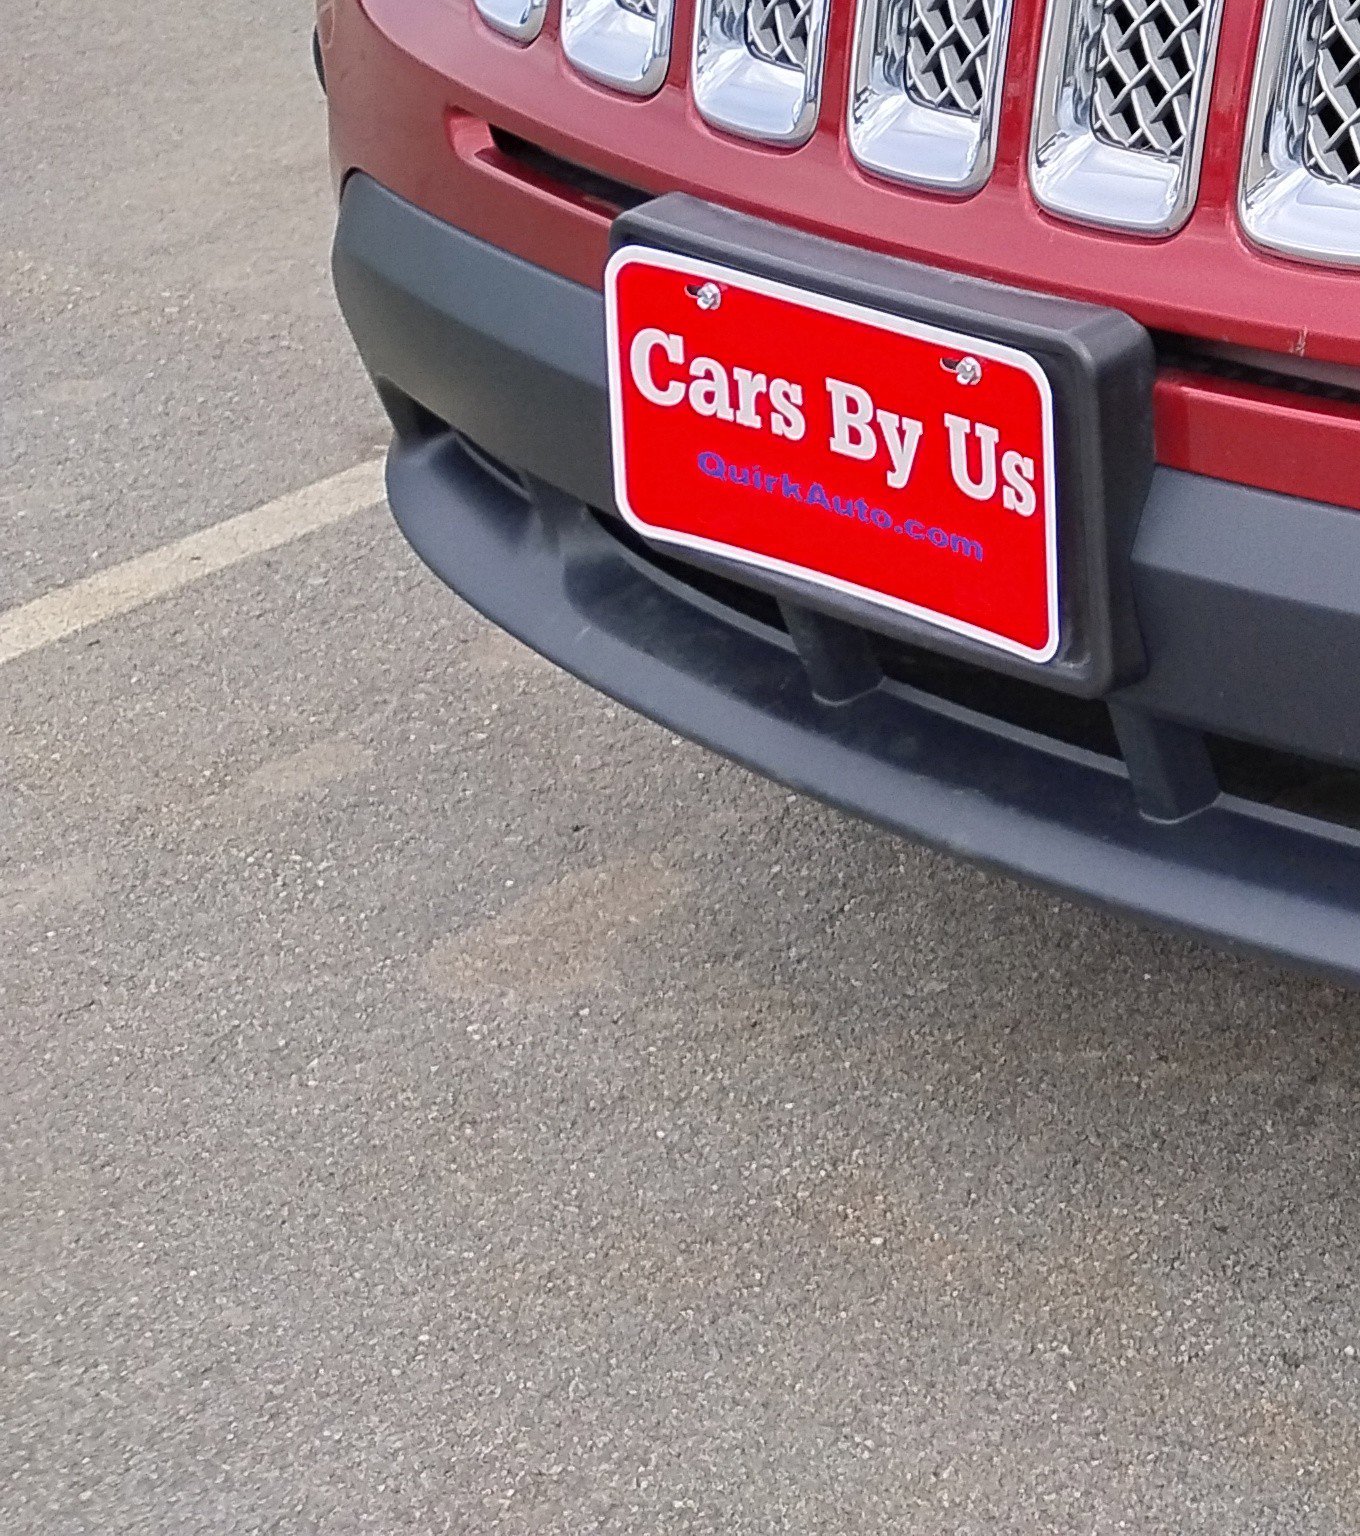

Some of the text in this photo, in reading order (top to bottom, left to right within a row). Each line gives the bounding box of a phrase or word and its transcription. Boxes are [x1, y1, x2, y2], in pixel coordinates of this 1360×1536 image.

[629, 327, 1038, 517] Cars By Us
[696, 451, 984, 562] QuirkAuto.com
